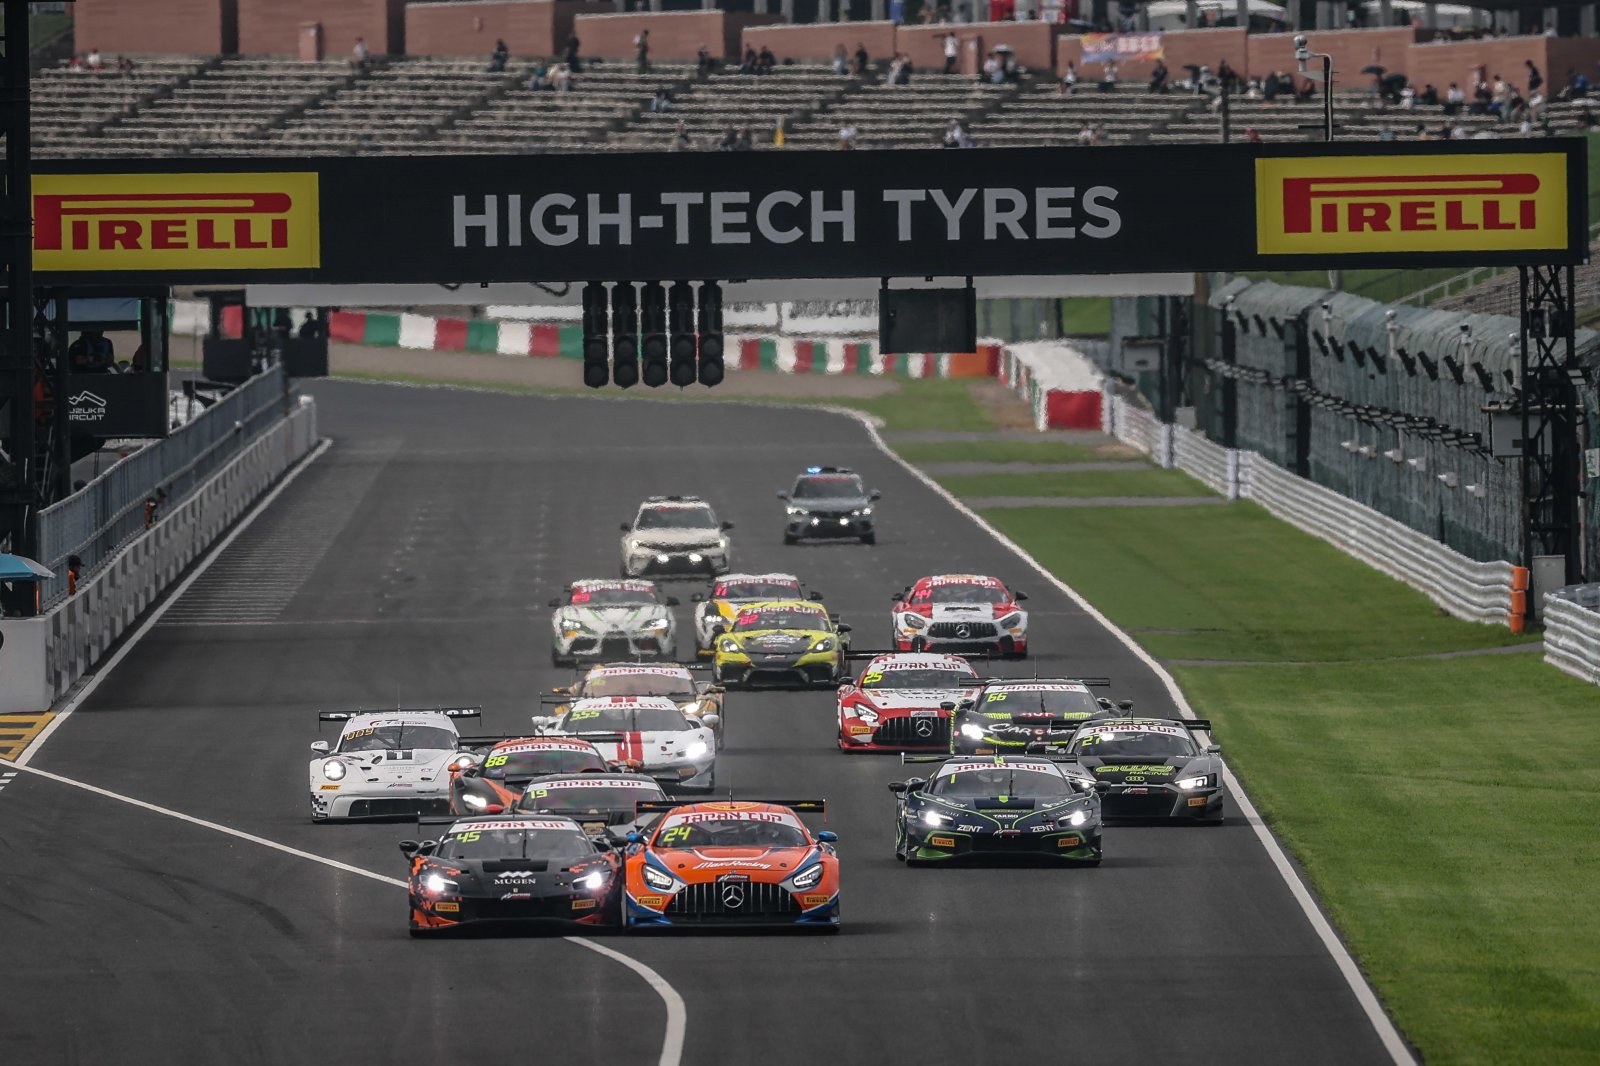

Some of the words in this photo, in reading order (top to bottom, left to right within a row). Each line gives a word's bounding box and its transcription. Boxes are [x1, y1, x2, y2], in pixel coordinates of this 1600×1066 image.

[1283, 173, 1540, 233] PIRELLI
[34, 192, 292, 250] PIRELLI
[452, 189, 855, 248] HIGH-TECH
[883, 186, 1122, 241] TYRES
[744, 606, 790, 616] JAPAN
[793, 606, 819, 615] CUP
[880, 663, 929, 671] JAPAN
[863, 673, 884, 684] 25
[986, 693, 1007, 703] 66
[1090, 725, 1141, 734] JAPAN
[1146, 725, 1177, 733] CUP
[499, 744, 552, 754] JAPAN
[485, 756, 508, 768] 88
[530, 790, 548, 799] 19
[681, 812, 741, 824] JAPAN
[748, 814, 783, 822] CUP
[957, 824, 984, 833] ZENT
[1029, 824, 1055, 833] ZENT
[456, 831, 482, 843] 45
[663, 827, 692, 843] 24
